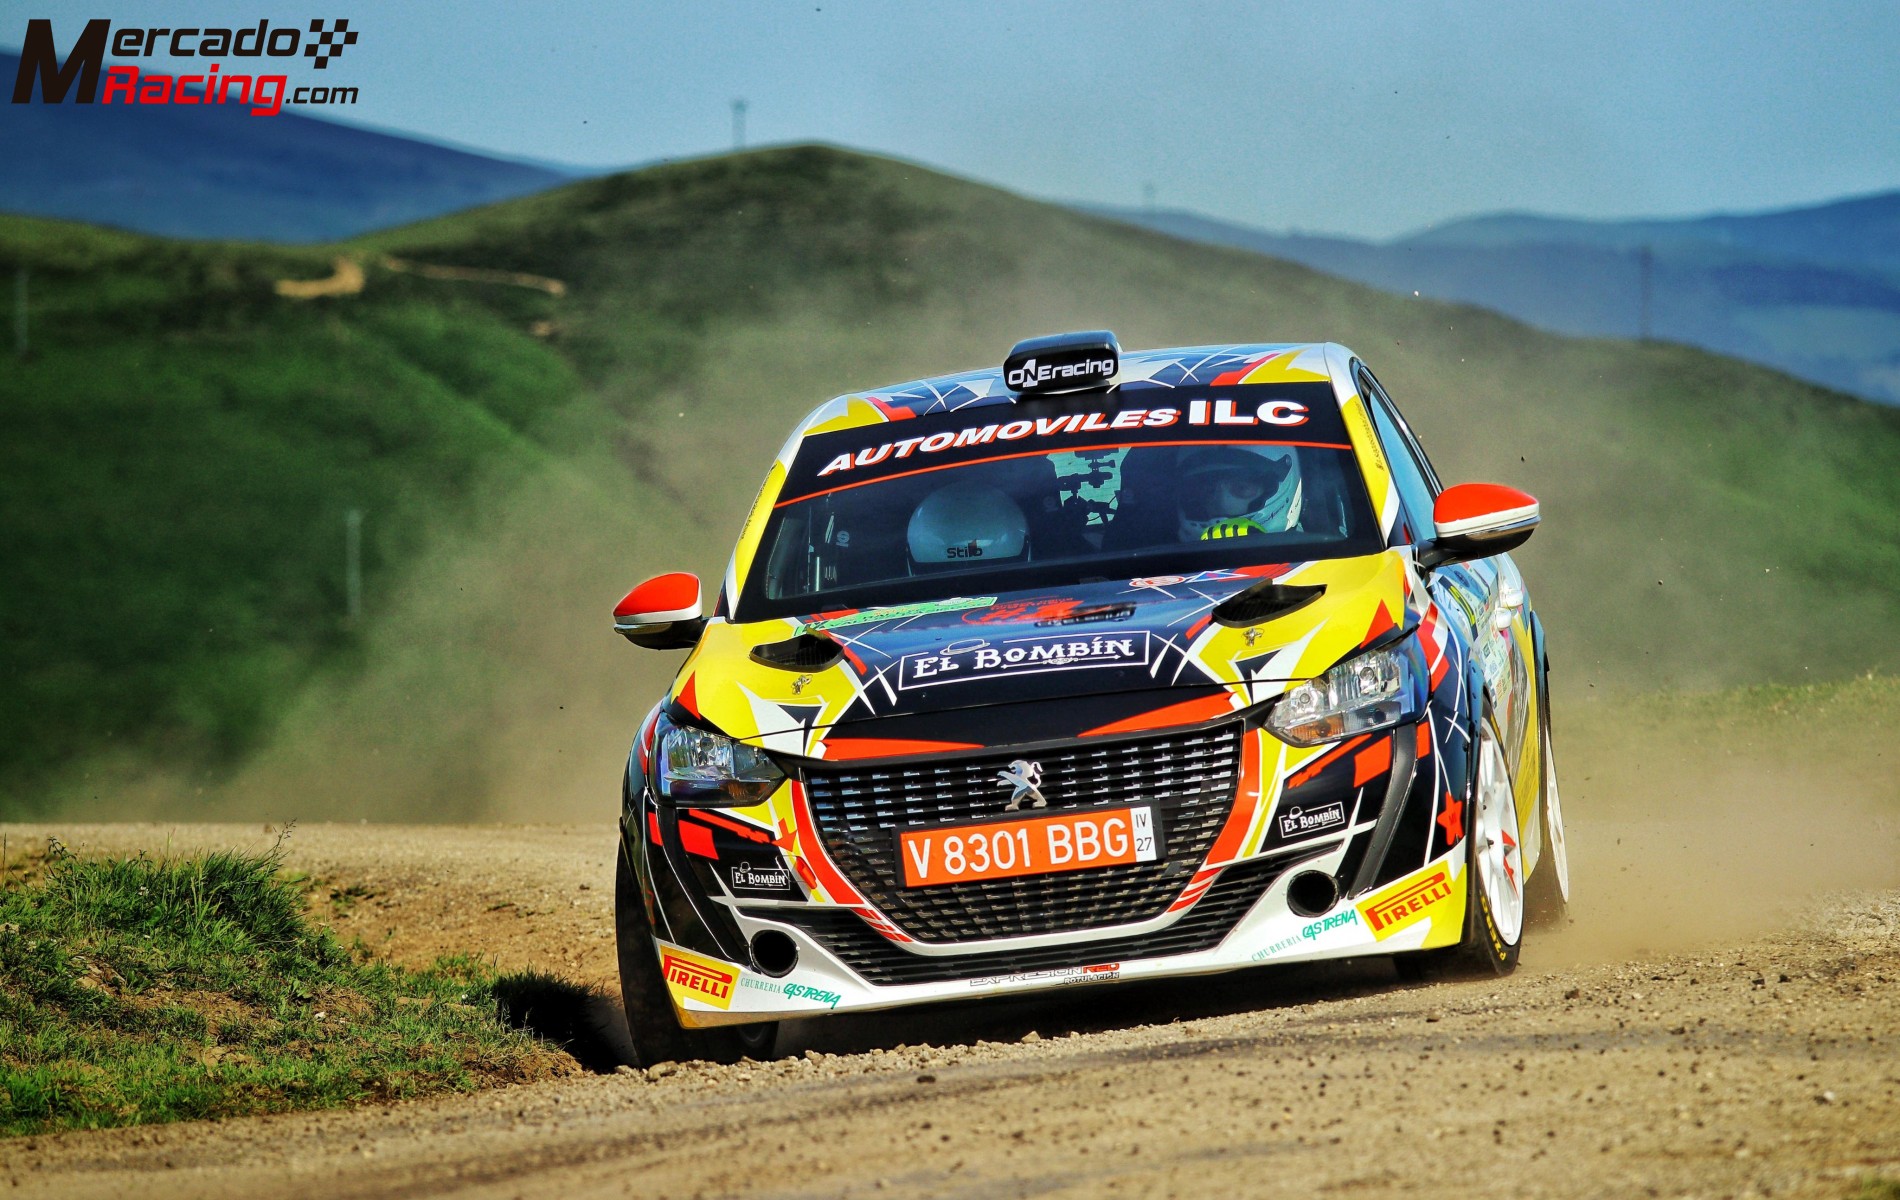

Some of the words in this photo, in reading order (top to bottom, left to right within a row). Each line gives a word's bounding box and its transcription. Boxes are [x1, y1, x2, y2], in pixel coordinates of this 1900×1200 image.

[817, 408, 1182, 477] AUTOMOVILES
[1188, 400, 1310, 427] ILC
[913, 656, 960, 679] EL
[973, 636, 1135, 670] BOMBÍN
[1135, 813, 1147, 828] IV
[1284, 820, 1298, 832] EL
[1300, 807, 1341, 829] BOMBÍN
[908, 838, 931, 879] V
[944, 828, 1031, 875] 8301
[1046, 817, 1129, 865] BBG
[1136, 837, 1152, 852] 27
[735, 872, 746, 884] EL
[748, 871, 787, 886] BOMBÍN
[1365, 871, 1451, 931] PIRELLI
[663, 954, 733, 999] PIRELLI
[740, 977, 781, 994] CHURRERIA
